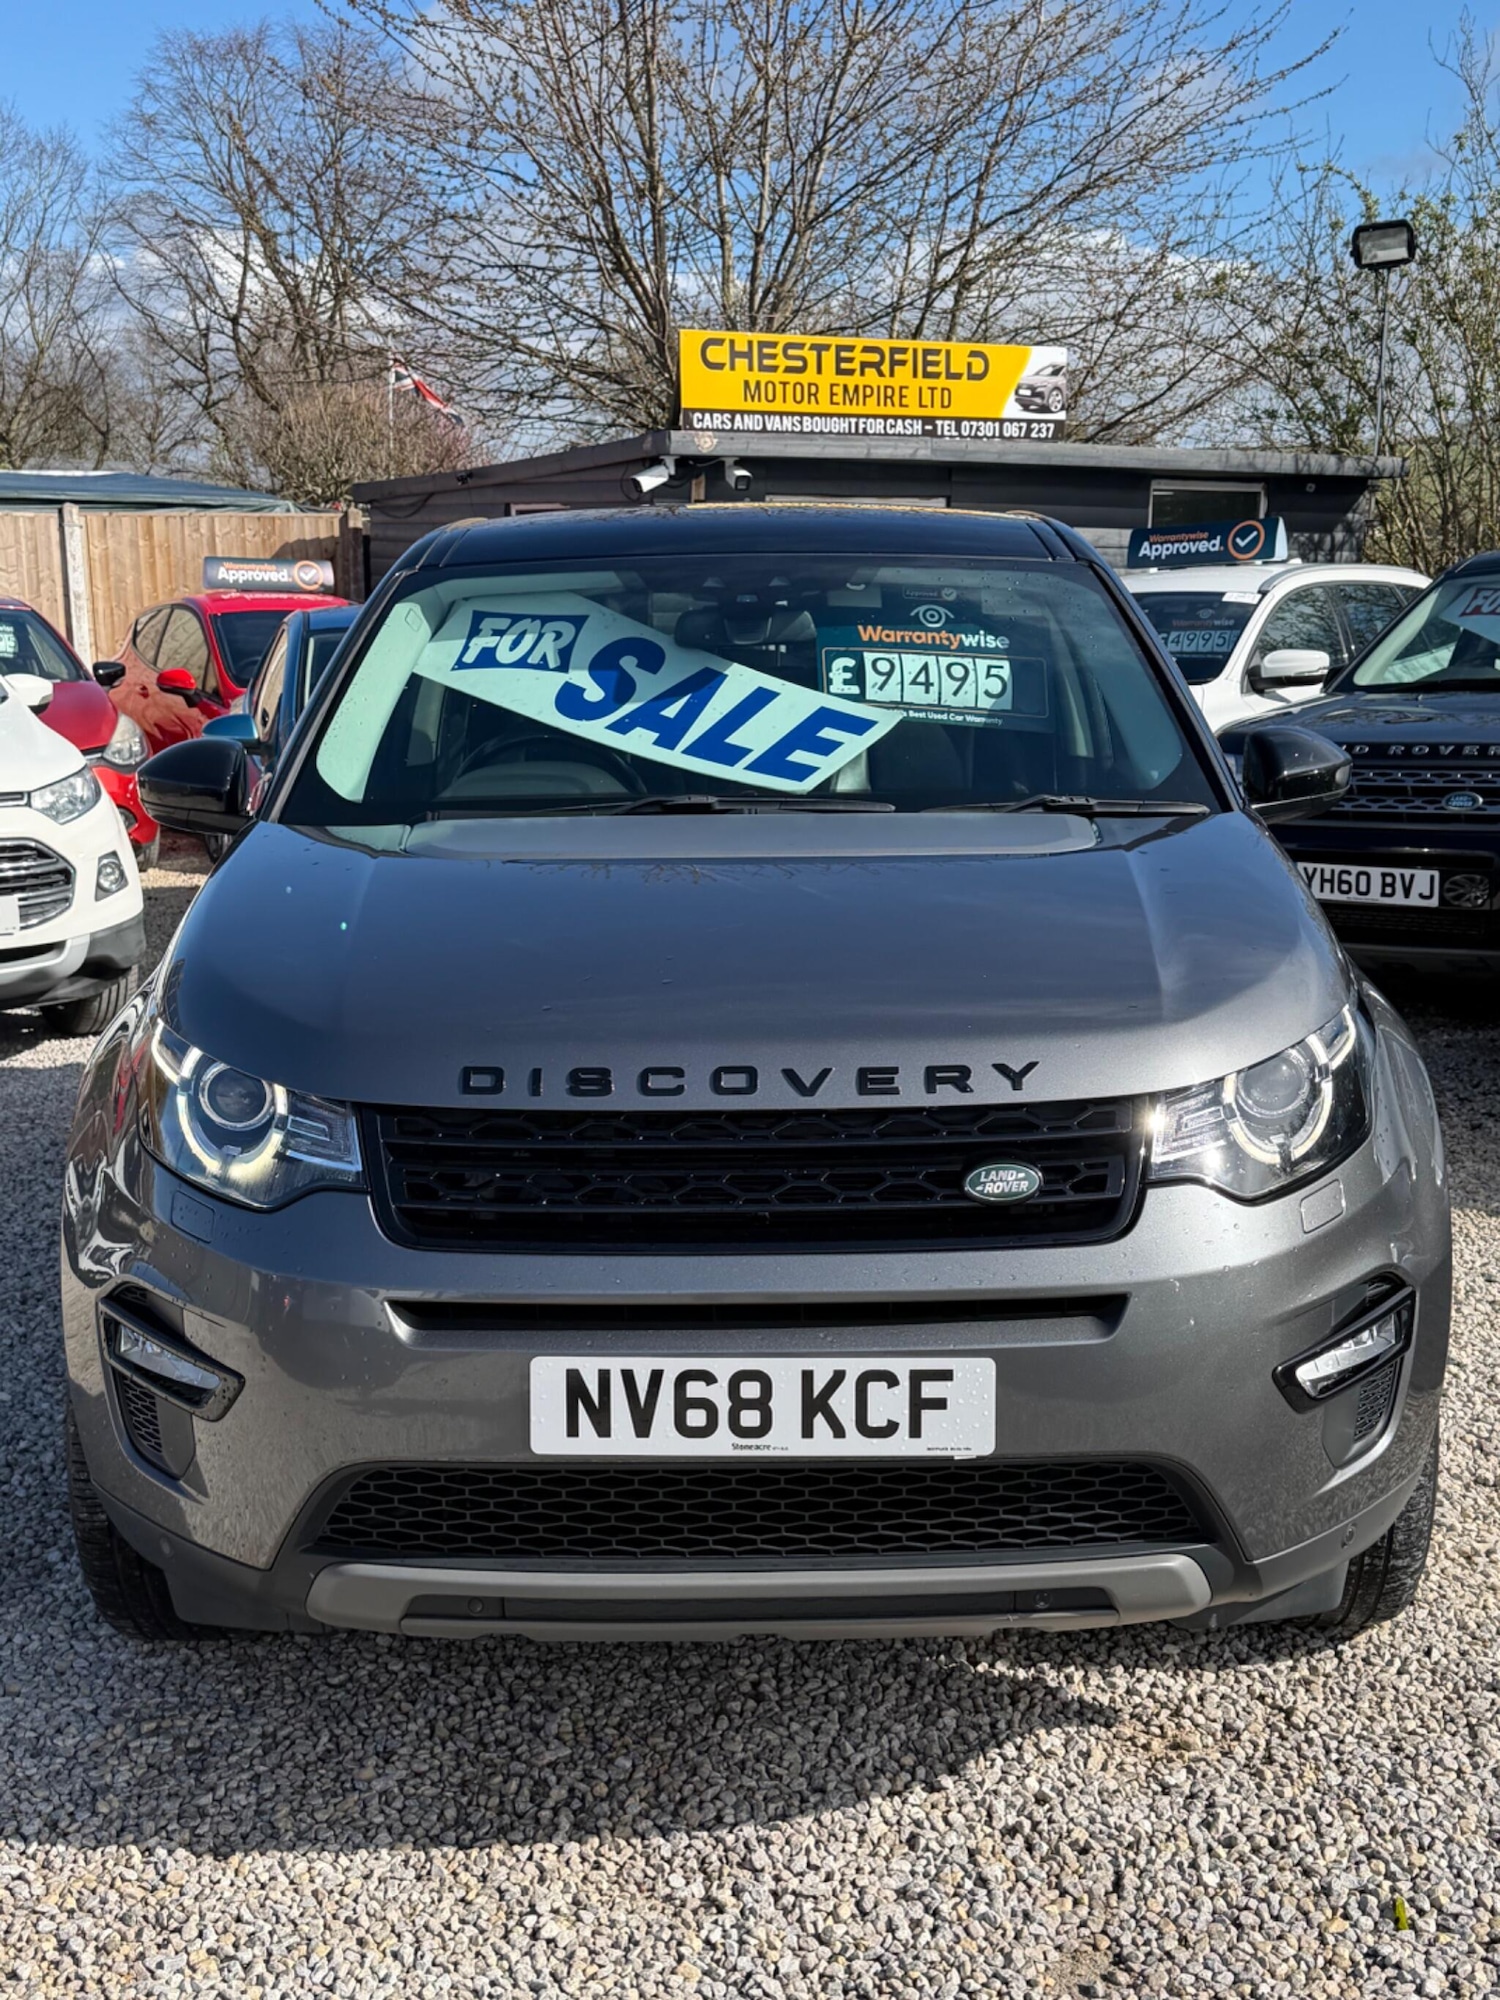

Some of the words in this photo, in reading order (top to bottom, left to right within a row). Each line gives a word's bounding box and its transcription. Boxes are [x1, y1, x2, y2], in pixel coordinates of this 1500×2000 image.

[700, 337, 990, 381] CHESTERFIELD
[743, 379, 820, 405] MOTOR
[829, 382, 910, 408] EMPIRE
[918, 386, 952, 409] LTD
[692, 412, 732, 429] CARS
[733, 413, 763, 430] AND
[764, 415, 802, 432] VANS
[802, 416, 859, 434] BOUGHT
[859, 418, 885, 434] FOR
[886, 418, 922, 435] CASH
[935, 420, 959, 436] TEL
[961, 421, 1000, 437] 07301
[1002, 422, 1026, 438] 067
[1029, 422, 1055, 438] 237
[1464, 589, 1500, 614] FO
[463, 616, 577, 670] FOR
[857, 624, 1010, 650] Warrantywise
[554, 636, 879, 783] SALE
[908, 710, 927, 719] Best
[927, 711, 948, 720] Used
[949, 713, 965, 721] Car
[1303, 866, 1371, 896] YH60
[1380, 872, 1435, 900] BVJ
[460, 1060, 1040, 1098] DISCOVERY
[980, 1170, 1017, 1182] LAND
[984, 1181, 1029, 1193] ROVER
[566, 1368, 773, 1439] NV68
[800, 1368, 954, 1439] KCF
